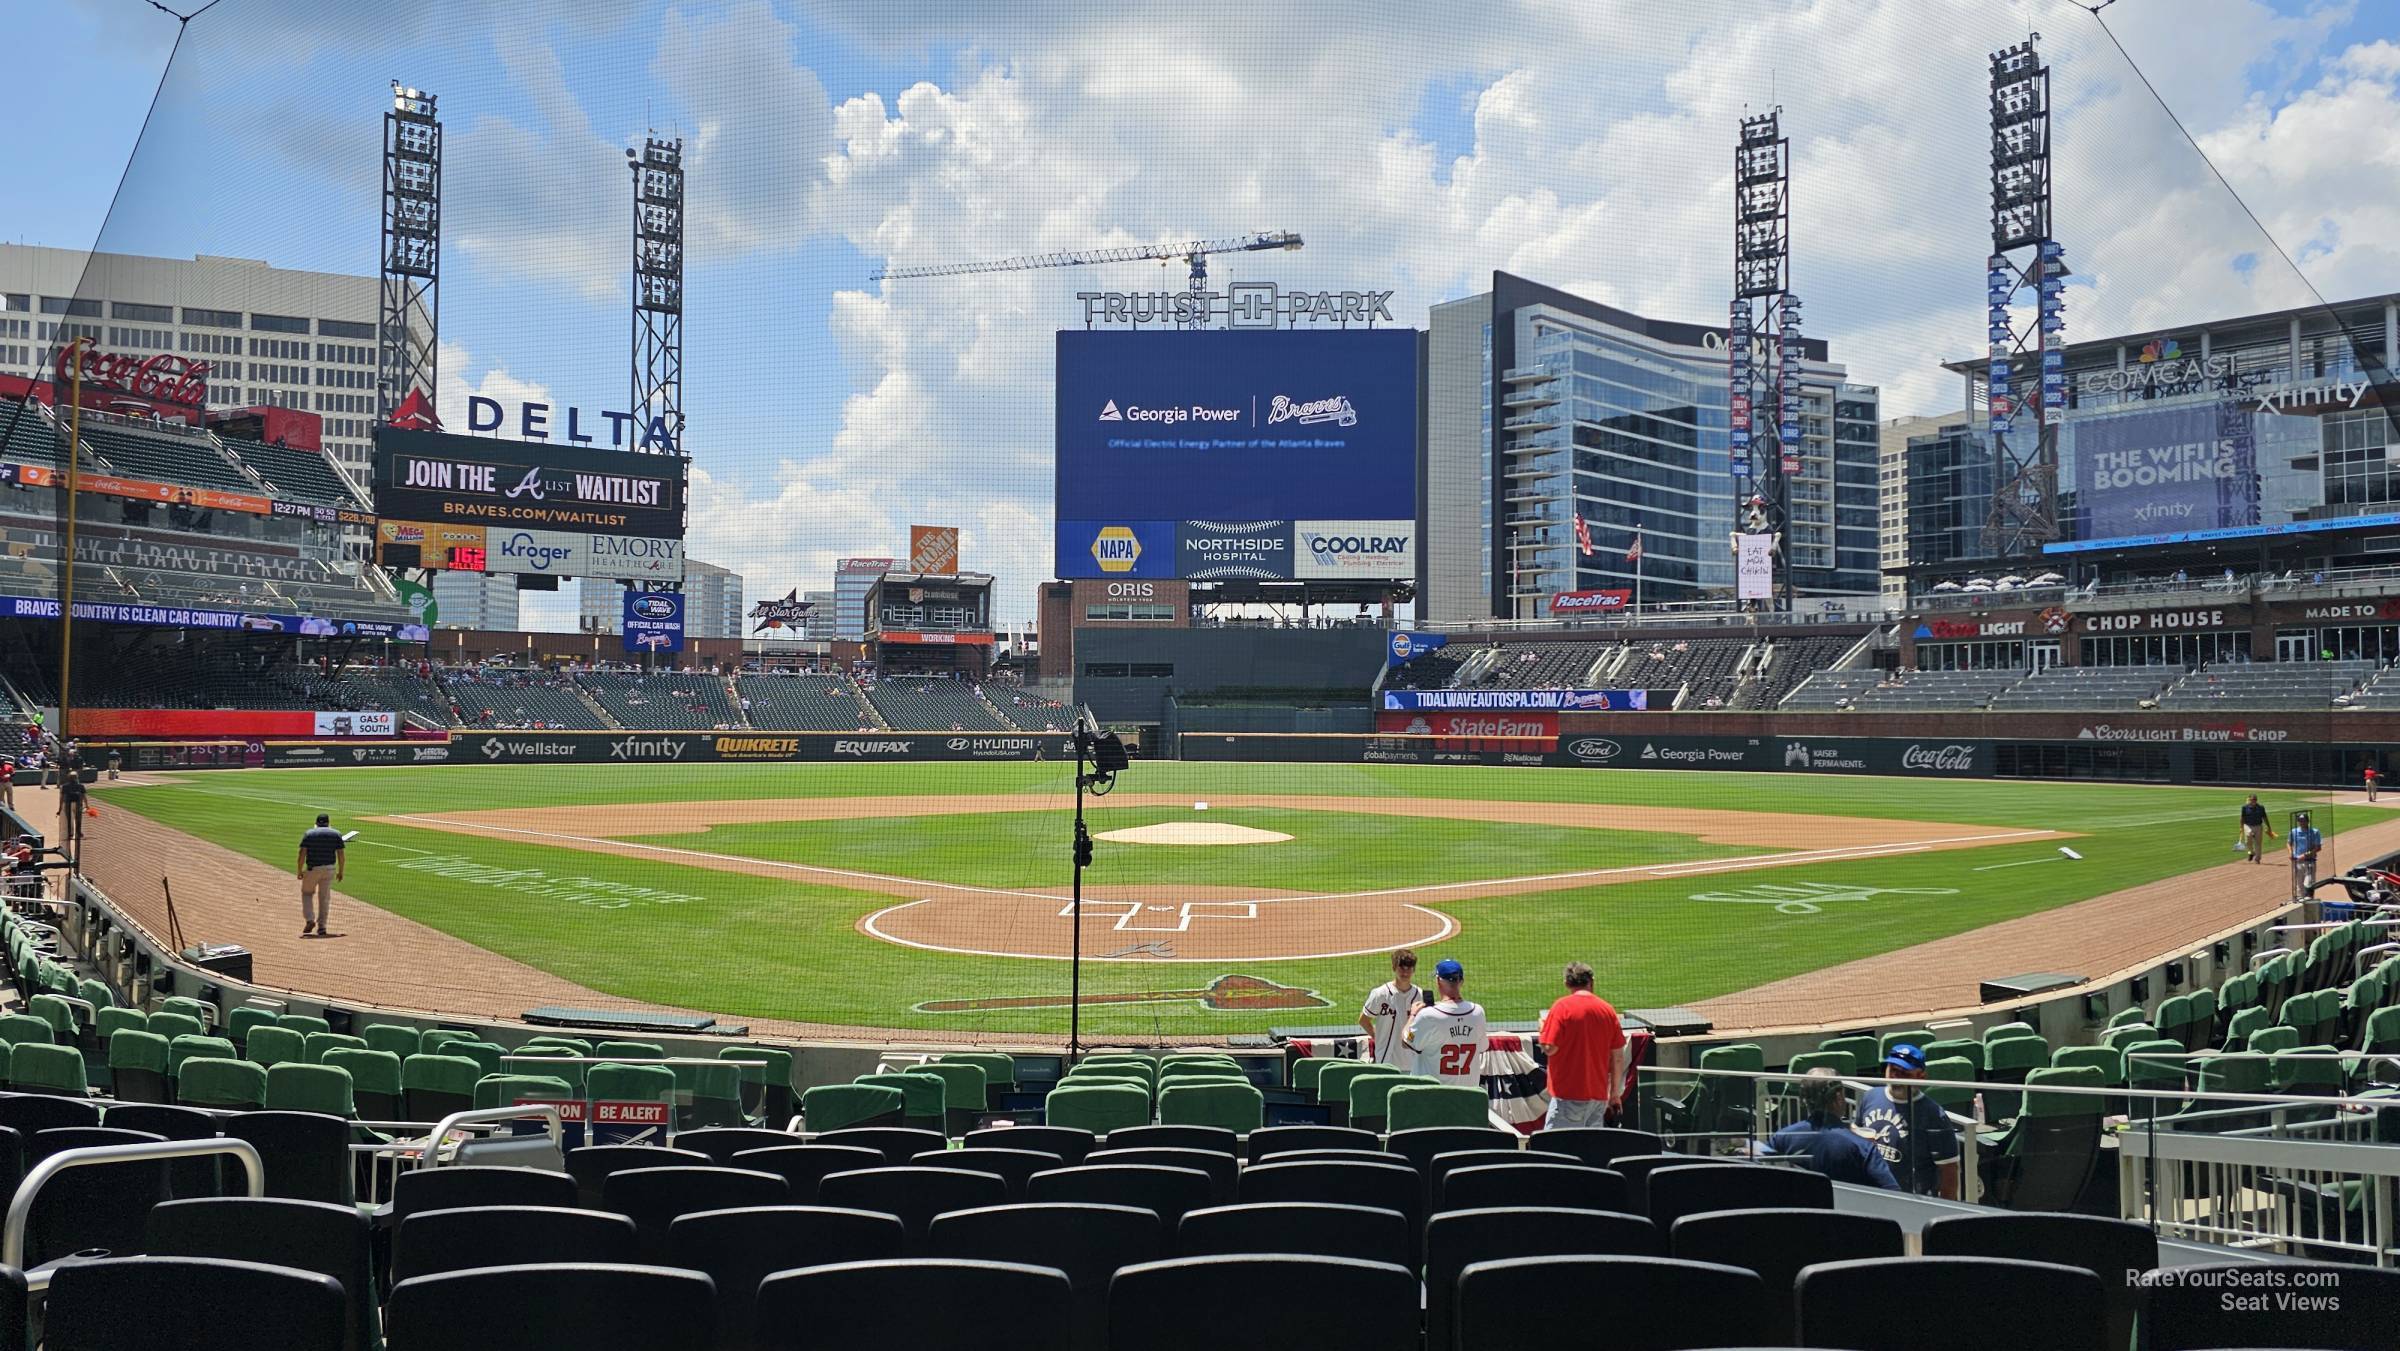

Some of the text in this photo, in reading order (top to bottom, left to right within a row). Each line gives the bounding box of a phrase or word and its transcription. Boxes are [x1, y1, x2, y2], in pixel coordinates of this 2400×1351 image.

[1077, 291, 1394, 322] TRUIST PARK
[56, 336, 216, 405] Coca-Cola
[2086, 353, 2238, 393] COMCAST
[2256, 377, 2370, 416] xfinity
[1127, 406, 1240, 424] Georgia Power
[1268, 395, 1343, 424] Braves
[468, 395, 675, 451] DELTA
[1108, 439, 1345, 451] Official Electric Energy Partner of the Atlanta Braves
[2094, 439, 2234, 471] THE WIFI IS
[2094, 457, 2235, 490] BOOMING
[405, 459, 451, 489] JOIN
[457, 463, 496, 492] THE
[546, 478, 571, 492] LIST
[575, 473, 661, 505] WAITLIST
[273, 502, 295, 514] 12:27
[297, 505, 311, 517] PM
[443, 502, 627, 526] BRAVES.COM/WAITLIST
[2134, 502, 2194, 520] xfinity
[593, 535, 678, 559] EMORY
[916, 531, 936, 550] THE
[1186, 538, 1284, 551] NORTHSIDE
[1311, 536, 1409, 553] COOLRAY
[502, 533, 572, 570] Kroger
[911, 527, 958, 573] HOME
[1100, 539, 1134, 559] NAPA
[1203, 552, 1266, 561] HOSPITAL
[1747, 547, 1763, 556] EAT
[592, 556, 673, 570] HEALTHCARE
[850, 560, 889, 569] RaceTrac
[1741, 567, 1769, 575] CHIKIN
[1107, 582, 1154, 597] ORIS
[1556, 592, 1621, 608] RaceTrac
[16, 599, 239, 627] BRAVES OUNTRY IS CLEAN CAR COUNTRY
[650, 606, 671, 614] WAVE
[747, 605, 819, 619] All Star Game
[2306, 605, 2375, 619] MADE TO
[375, 624, 393, 632] WAVE
[627, 621, 651, 629] OFFICIAL
[665, 622, 681, 630] WASH
[1980, 621, 2025, 636] LIGHT
[2086, 610, 2224, 631] CHOP HOUSE
[921, 633, 955, 643] WORKING
[1394, 641, 1409, 649] Gulf
[1416, 691, 1563, 708] TIDALWAVEAUTOSPA.COM/
[360, 715, 379, 723] GAS
[359, 724, 390, 733] SOUTH
[2095, 724, 2137, 740] Coors
[2138, 729, 2177, 740] LIGHT
[2183, 728, 2230, 740] BELOW
[2248, 728, 2288, 740] CHOP
[509, 742, 576, 755] Wellstar
[611, 736, 686, 759] xfinity
[715, 737, 799, 752] QUIKRETE
[834, 740, 911, 757] EQUIFAX
[973, 738, 1033, 749] HYUNDAI
[1577, 740, 1611, 756] Ford
[1513, 753, 1544, 761] National
[1661, 748, 1744, 761] Georgia Power
[1902, 744, 1976, 770] Coca-Cola
[1813, 760, 1864, 768] PERMANENTE
[1450, 1025, 1473, 1038] RILEY
[1440, 1044, 1477, 1075] 27
[600, 1106, 662, 1120] BE ALERT
[1864, 1108, 1909, 1140] ATLANTA
